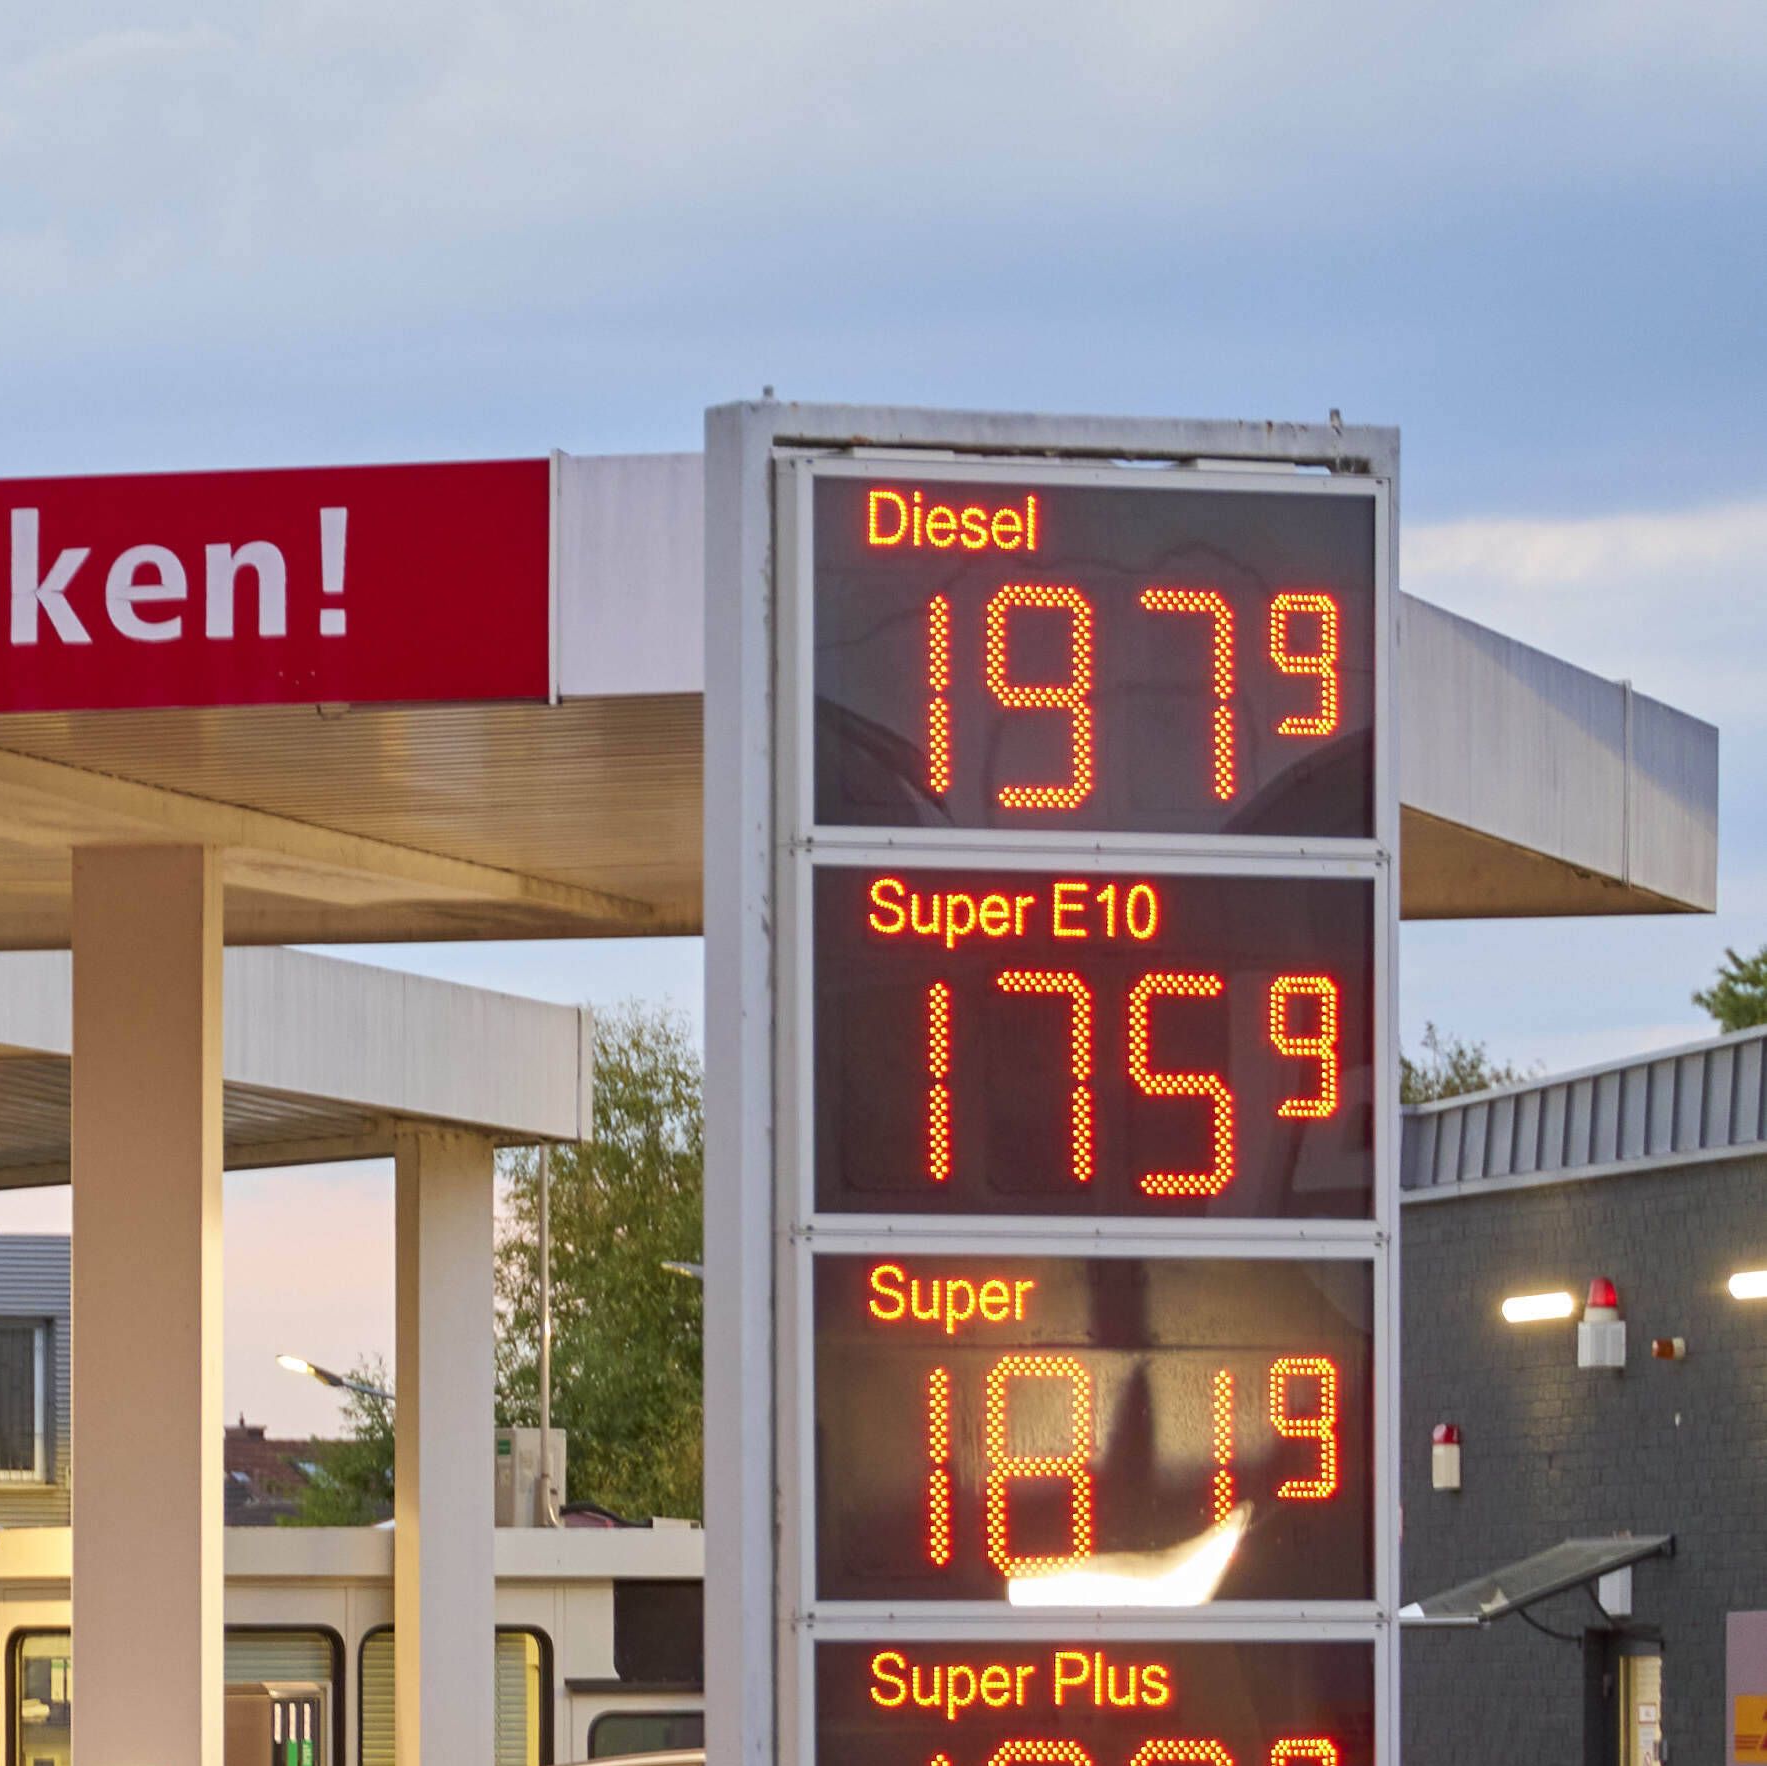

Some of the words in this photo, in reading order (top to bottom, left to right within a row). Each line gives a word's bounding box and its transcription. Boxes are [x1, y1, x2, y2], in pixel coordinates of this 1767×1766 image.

[867, 489, 1038, 552] Diesel
[868, 877, 1035, 950] Super
[1053, 881, 1159, 940] E10
[868, 1263, 1035, 1335] Super
[869, 1650, 1036, 1721] Super
[1054, 1650, 1171, 1708] Plus
